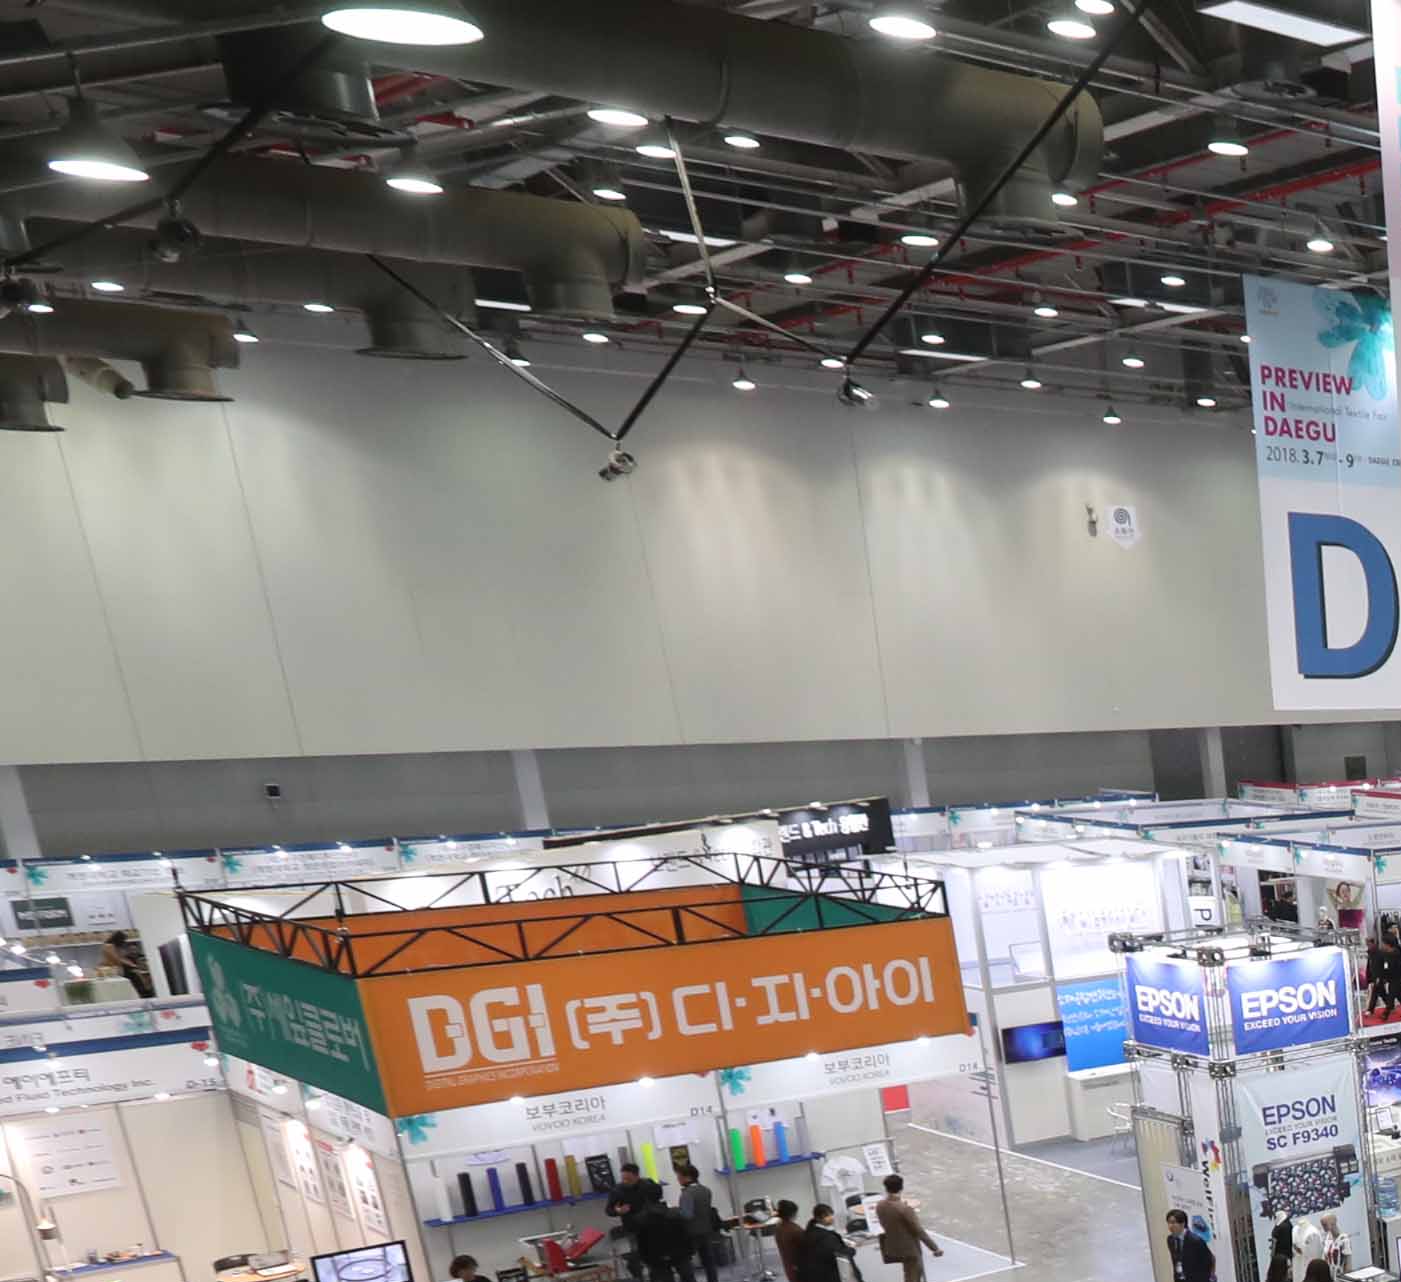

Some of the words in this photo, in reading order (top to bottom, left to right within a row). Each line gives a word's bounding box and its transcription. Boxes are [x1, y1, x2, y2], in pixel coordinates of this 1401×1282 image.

[1260, 365, 1354, 395] PREVIEW
[1262, 391, 1286, 412] IN
[1264, 416, 1336, 443] DAEGU
[1288, 511, 1400, 679] D
[1135, 984, 1200, 1022] EPSON
[1240, 979, 1337, 1019] EPSON
[408, 984, 556, 1073] DGI
[1244, 1016, 1281, 1032] EXCEED
[1282, 1012, 1306, 1026] YOUR
[1308, 1008, 1338, 1021] VISION
[53, 1081, 128, 1097] Technology
[525, 1096, 607, 1120] 보부코리아
[1262, 1094, 1337, 1126] EPSON
[1266, 1136, 1288, 1151] SC
[1292, 1124, 1339, 1147] F9340
